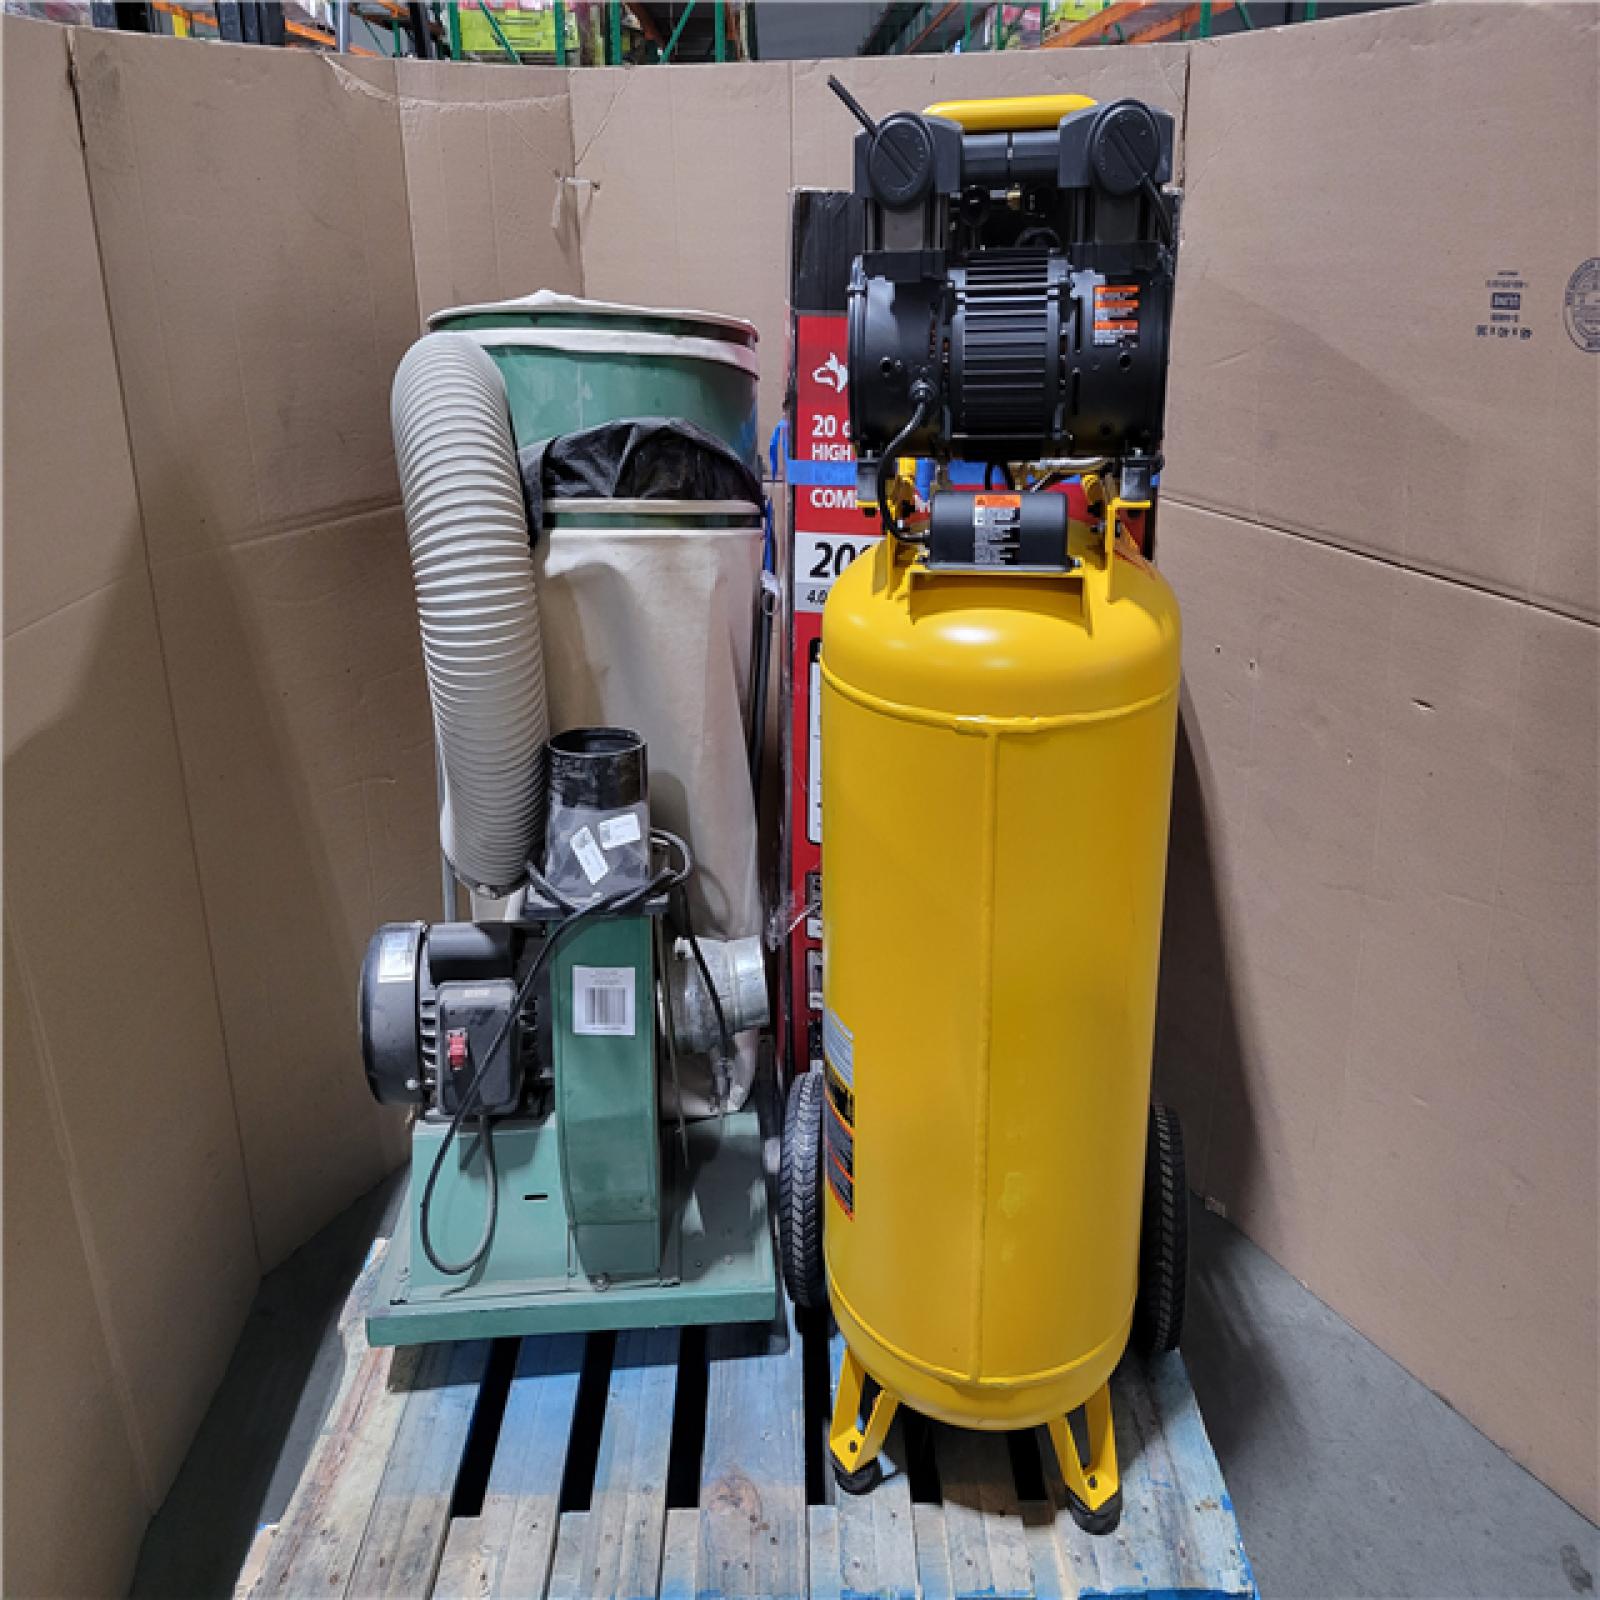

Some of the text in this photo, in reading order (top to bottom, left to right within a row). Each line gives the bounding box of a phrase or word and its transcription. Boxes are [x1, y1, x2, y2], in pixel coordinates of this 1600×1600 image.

[812, 414, 836, 437] 20
[811, 443, 851, 462] HIGH
[810, 488, 858, 510] COM
[810, 541, 874, 578] 20
